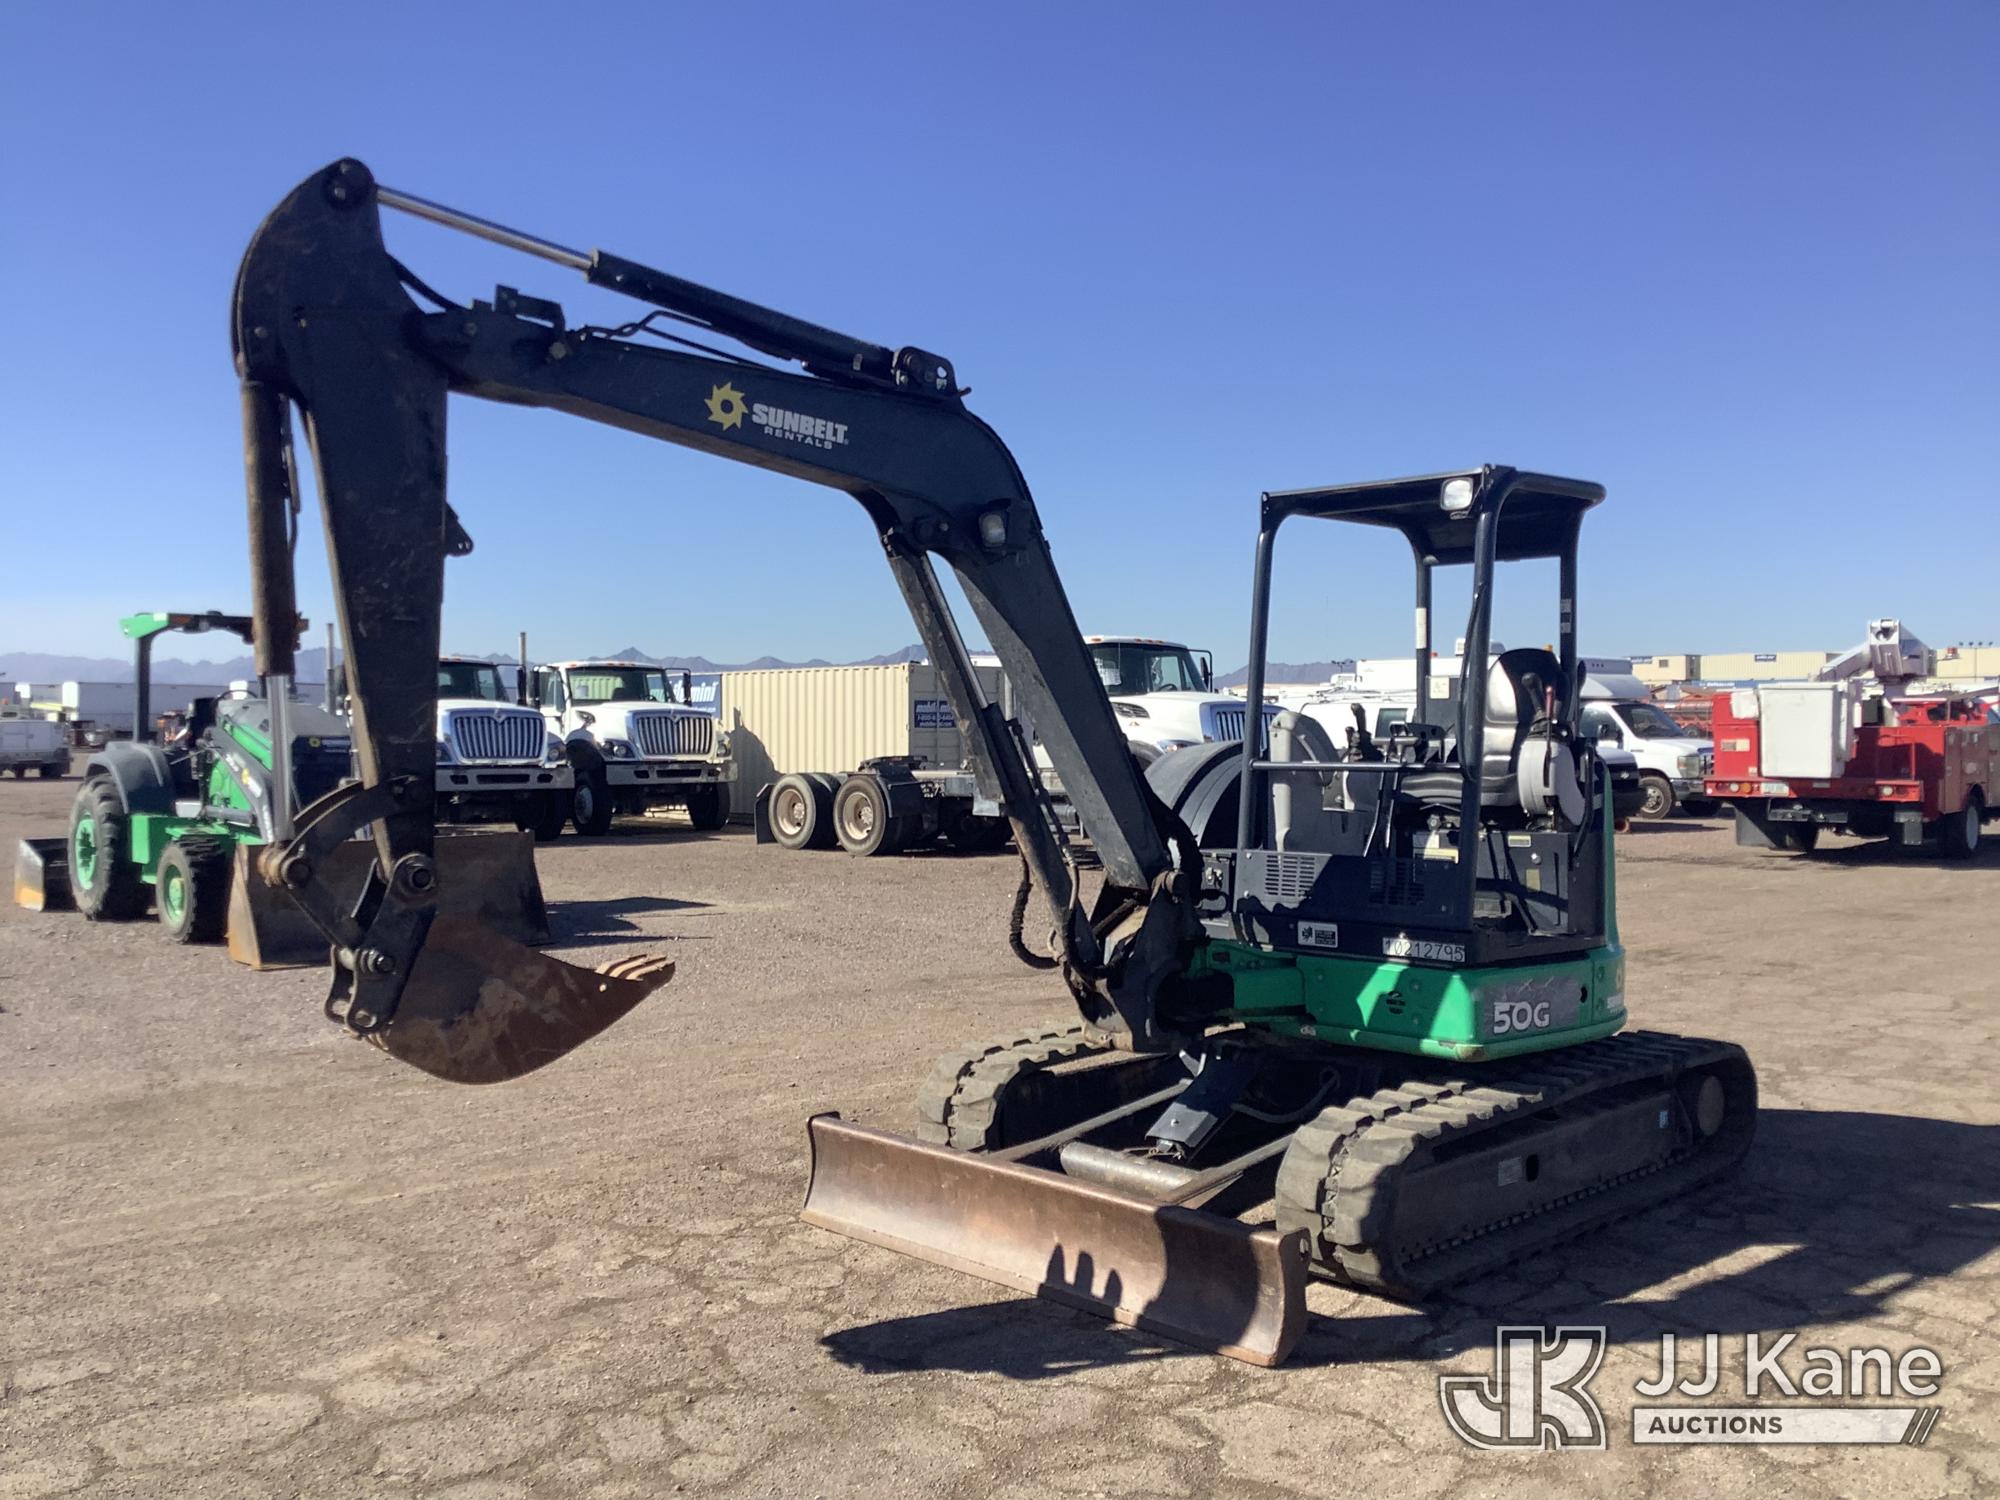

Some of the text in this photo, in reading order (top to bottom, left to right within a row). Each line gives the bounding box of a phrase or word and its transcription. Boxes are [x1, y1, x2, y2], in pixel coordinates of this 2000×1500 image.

[752, 403, 848, 444] SUNBELT
[764, 425, 832, 450] RENTALS
[1493, 1001, 1550, 1034] 50G
